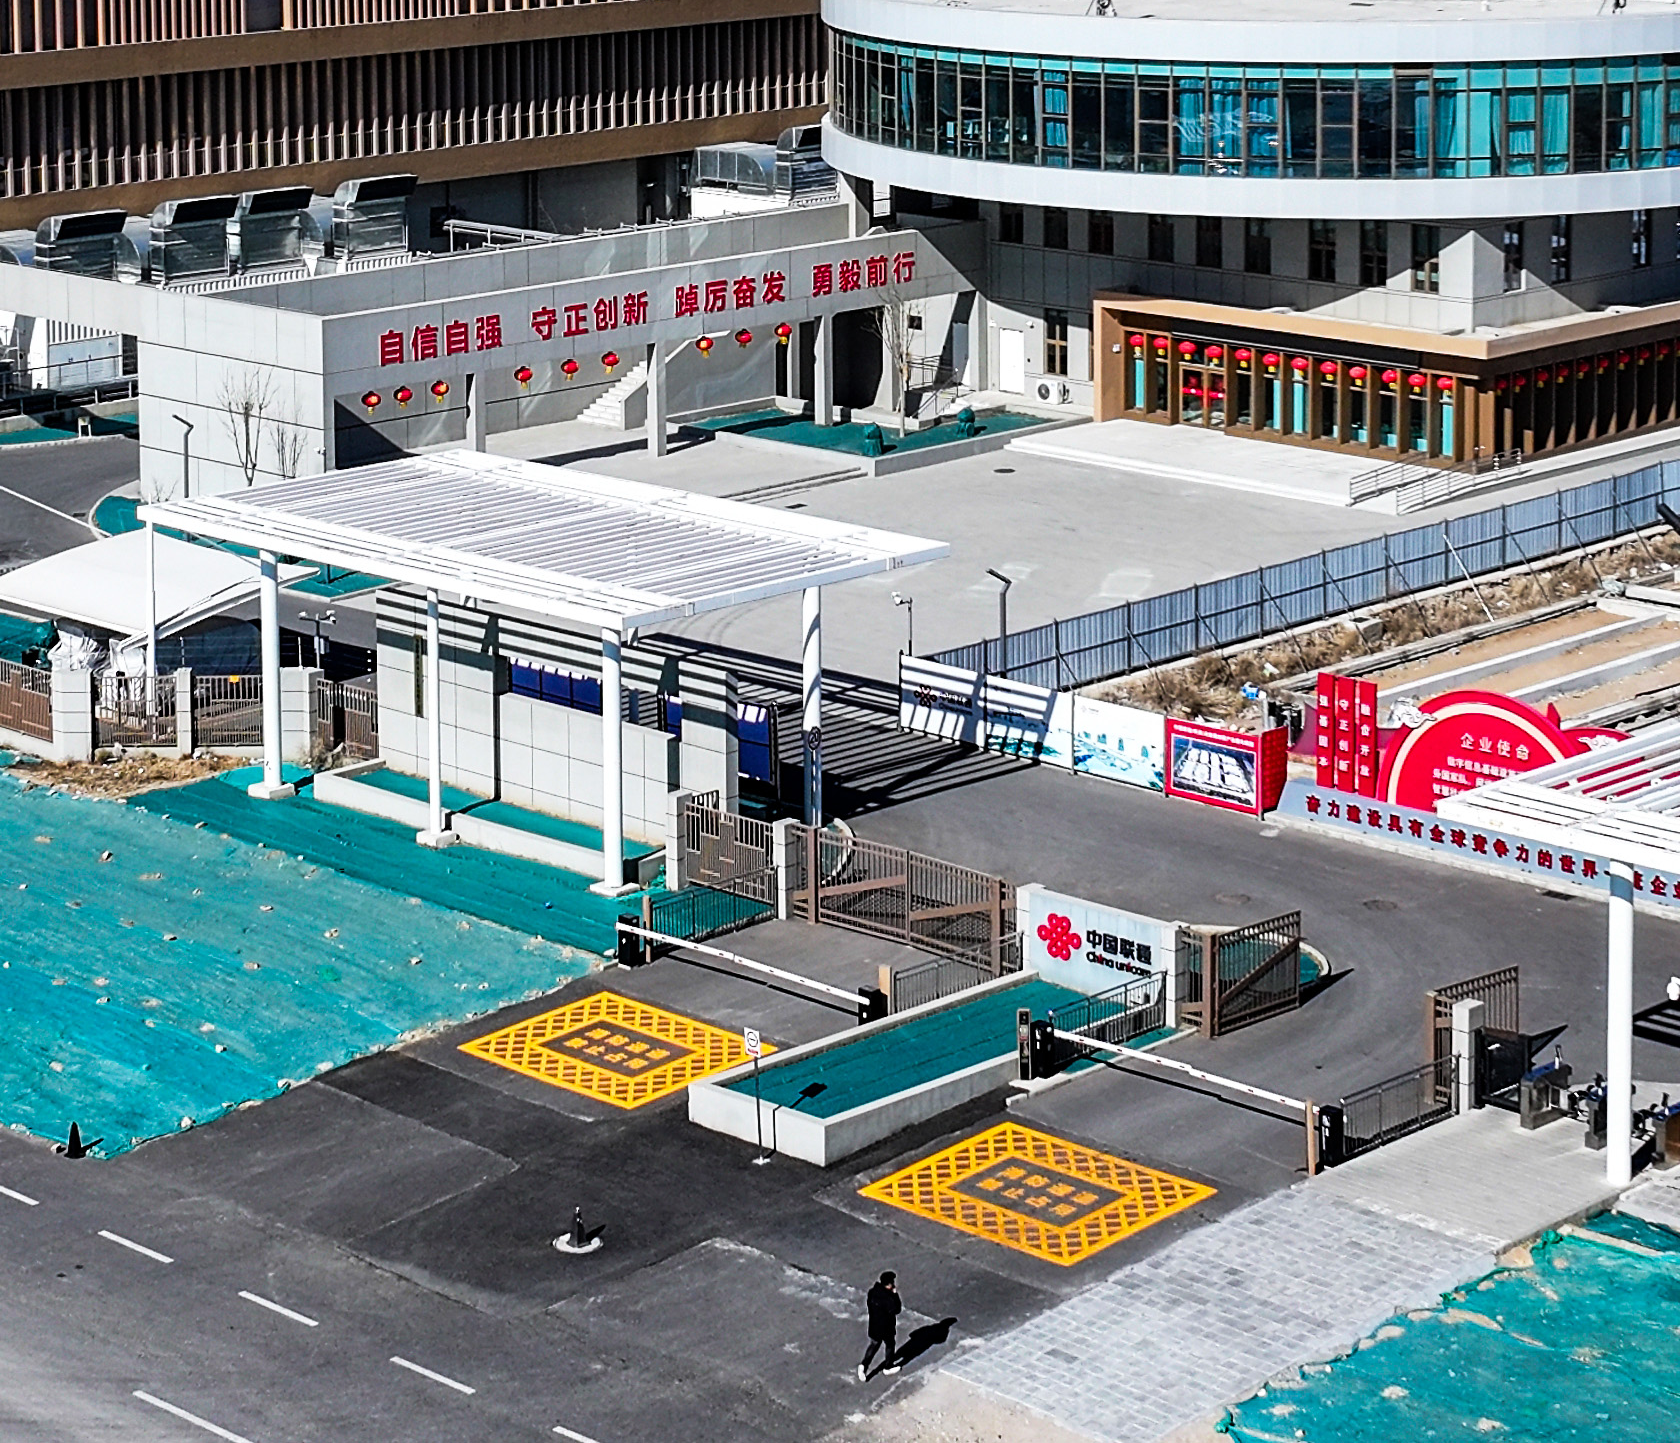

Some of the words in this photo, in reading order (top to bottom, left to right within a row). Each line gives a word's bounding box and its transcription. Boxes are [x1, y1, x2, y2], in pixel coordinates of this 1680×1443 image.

[380, 315, 503, 366] 自信自强
[531, 290, 648, 341] 守正创新
[675, 271, 786, 318] 踔厉奋发
[812, 251, 916, 298] 勇毅前行
[1339, 699, 1350, 773] 守正创新
[1460, 732, 1530, 761] 企业使命
[1086, 929, 1152, 965] 中国联通
[1086, 951, 1115, 969] China
